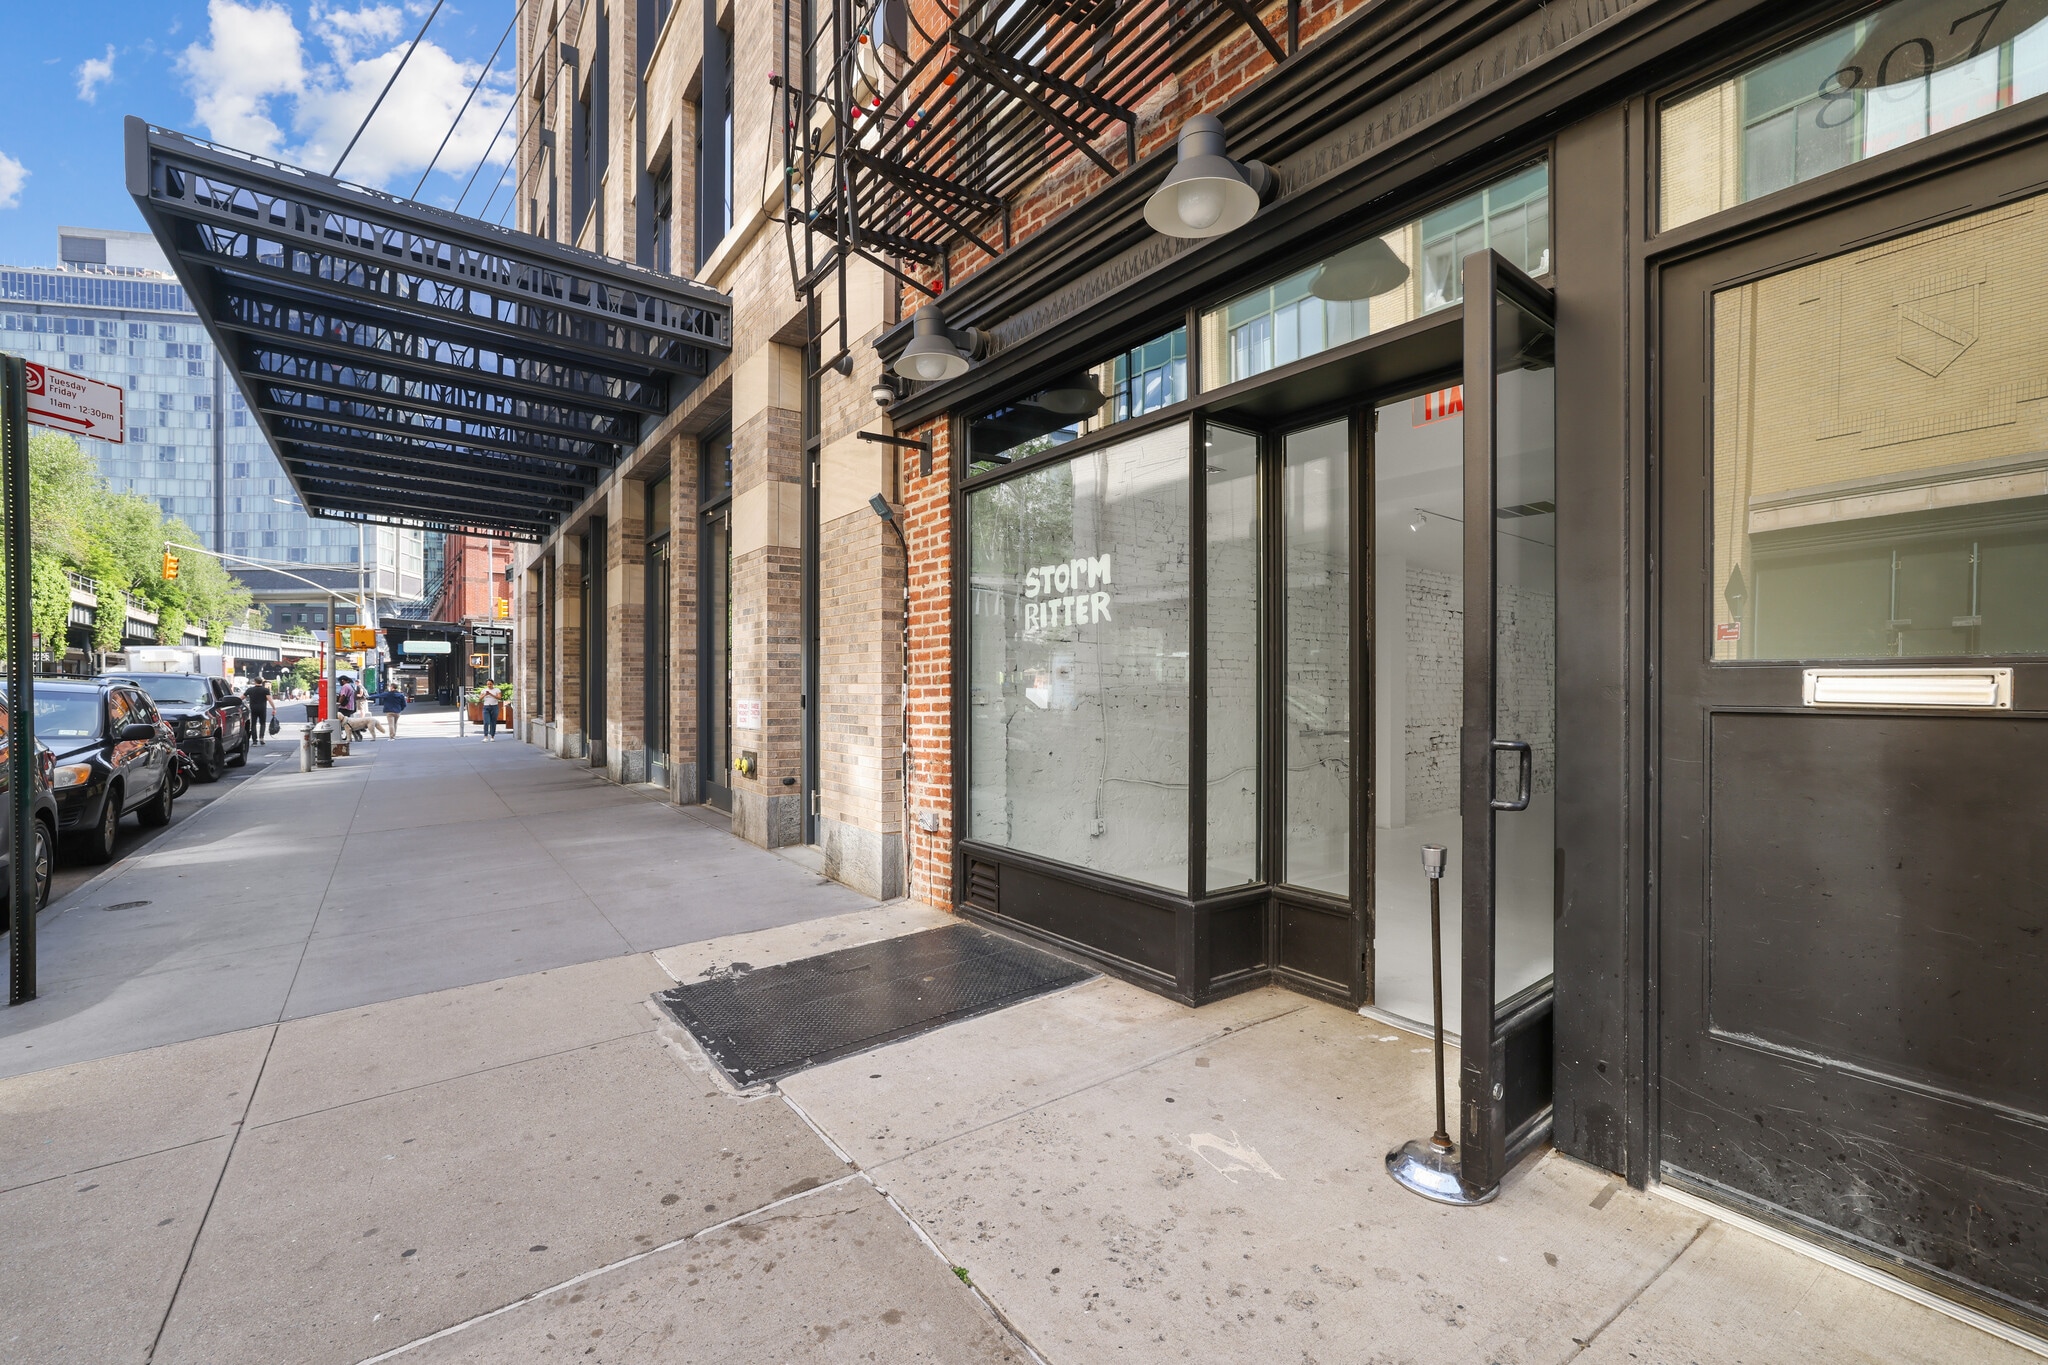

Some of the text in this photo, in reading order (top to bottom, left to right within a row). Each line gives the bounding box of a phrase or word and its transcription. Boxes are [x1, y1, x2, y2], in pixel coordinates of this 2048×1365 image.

[1816, 0, 2008, 128] 807
[49, 375, 87, 393] Tuesday
[49, 384, 77, 399] Friday
[49, 398, 71, 410] 11am
[79, 405, 114, 420] 12:30pm
